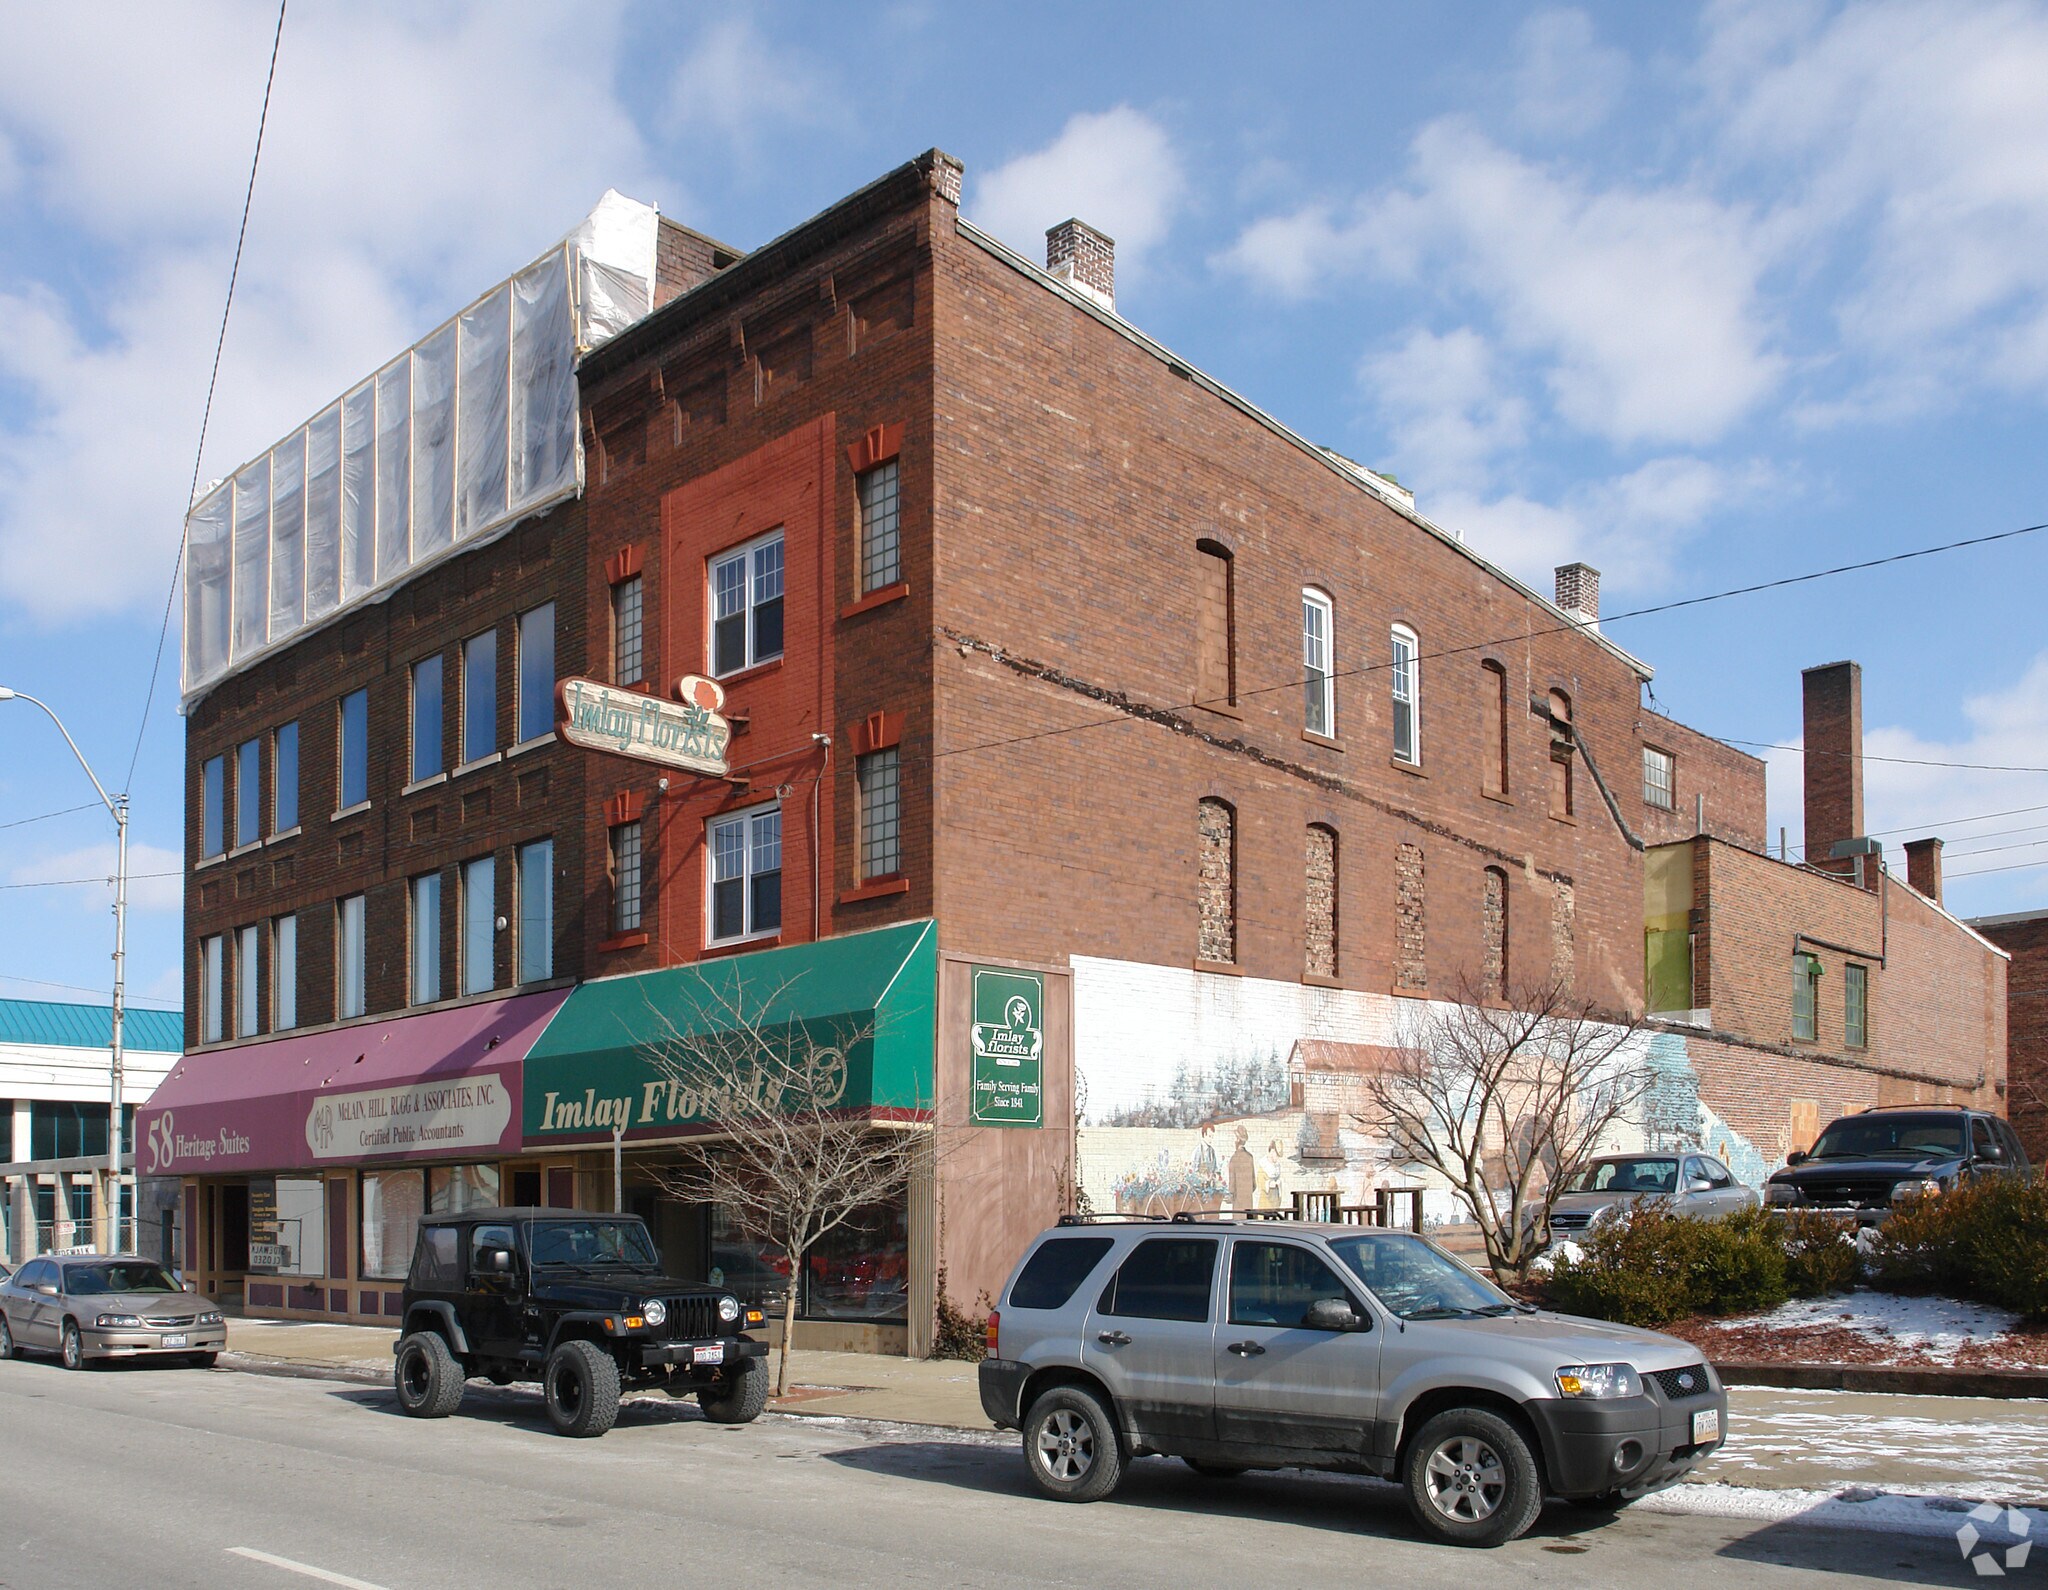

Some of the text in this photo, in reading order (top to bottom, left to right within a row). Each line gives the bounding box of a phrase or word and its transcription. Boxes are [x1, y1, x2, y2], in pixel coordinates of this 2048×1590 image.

[572, 682, 633, 750] Imlay
[987, 1040, 1029, 1055] florists
[991, 1028, 1025, 1045] Imlay
[390, 1094, 412, 1115] RUGG
[413, 1093, 420, 1113] &
[421, 1086, 474, 1112] ASSOCIATES,
[476, 1084, 495, 1106] INC.
[976, 1079, 1039, 1096] Family Serving Family
[539, 1068, 782, 1138] Imlay Florists
[994, 1096, 1010, 1107] Since
[146, 1110, 250, 1174] 58 Heritage Suites
[359, 1121, 464, 1147] Certified Public Accountants
